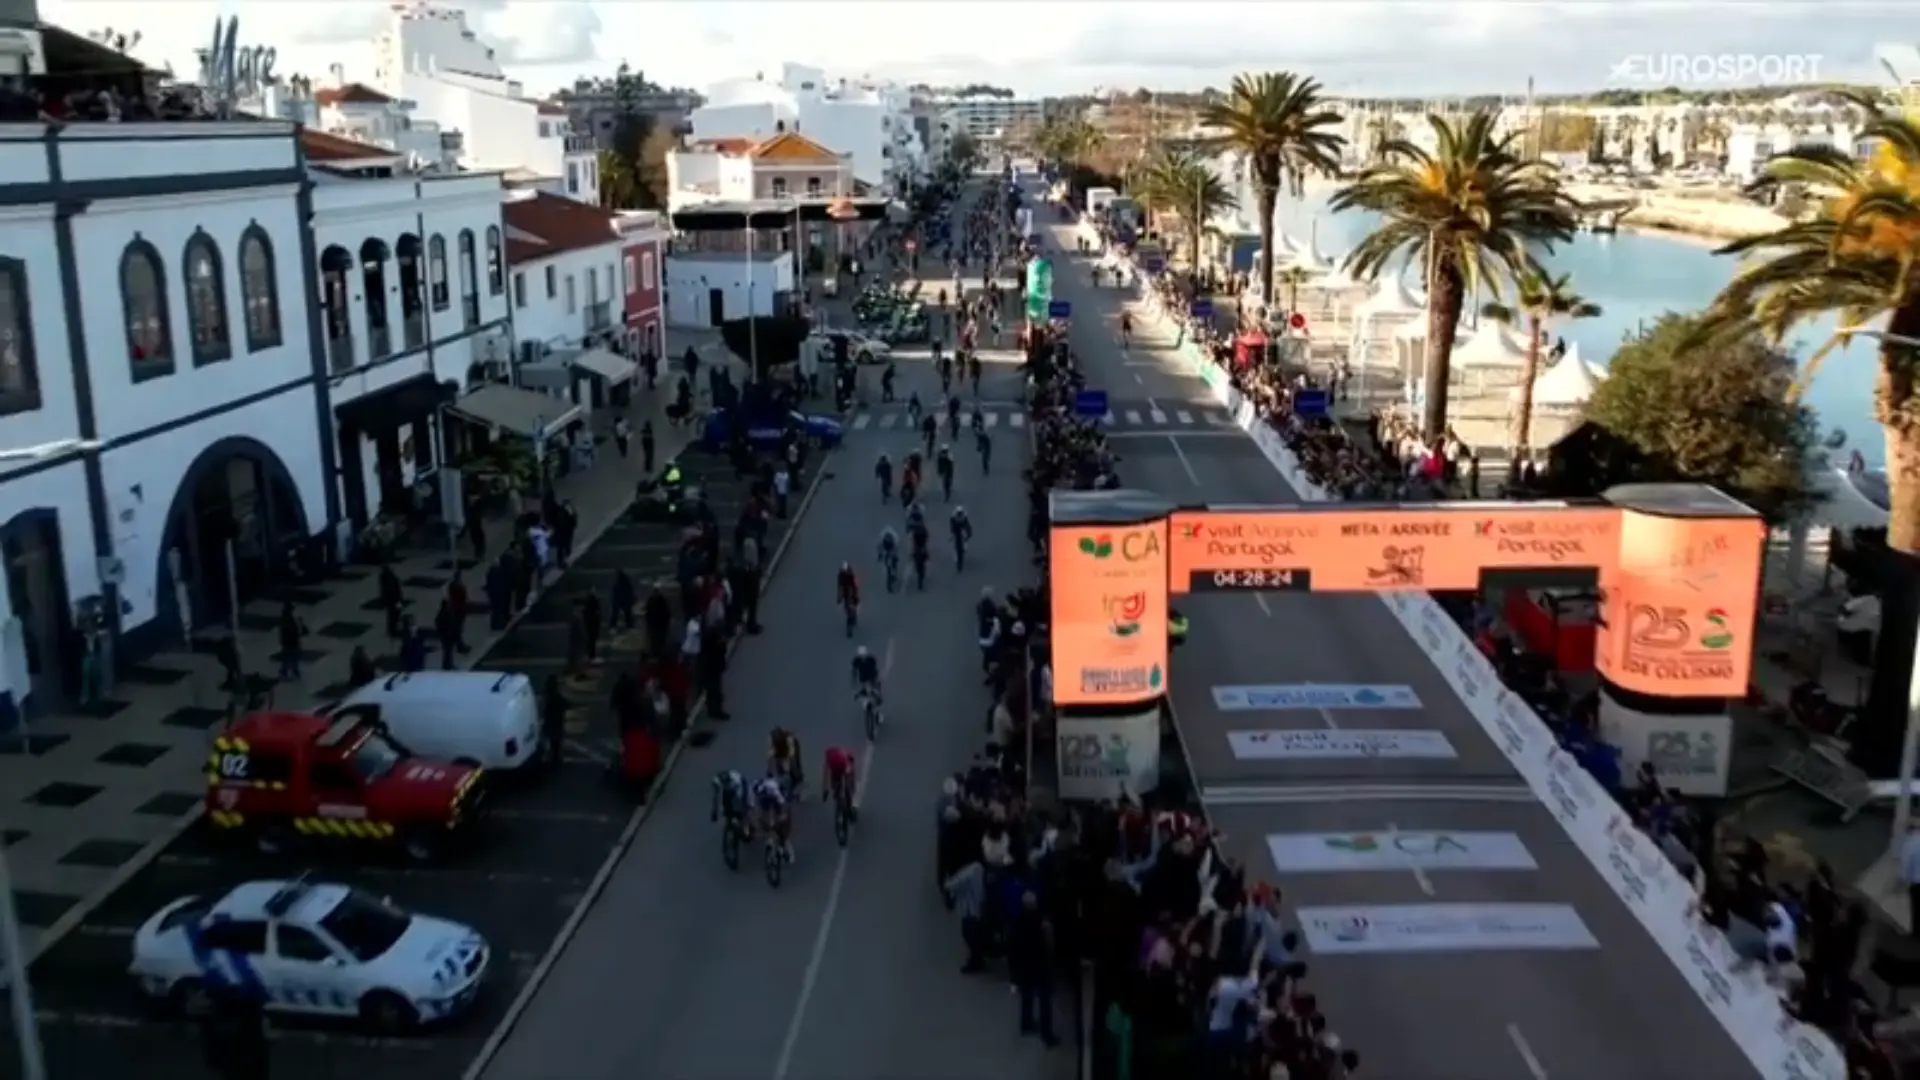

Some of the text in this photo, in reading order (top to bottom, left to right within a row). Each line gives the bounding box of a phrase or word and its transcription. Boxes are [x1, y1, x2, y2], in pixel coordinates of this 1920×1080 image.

[1207, 523, 1243, 538] visit
[1341, 523, 1379, 536] META
[1390, 521, 1452, 536] ARRIVÉE
[1122, 530, 1161, 563] CA
[1206, 540, 1295, 563] Portugal
[1213, 570, 1293, 587] 04:28:24
